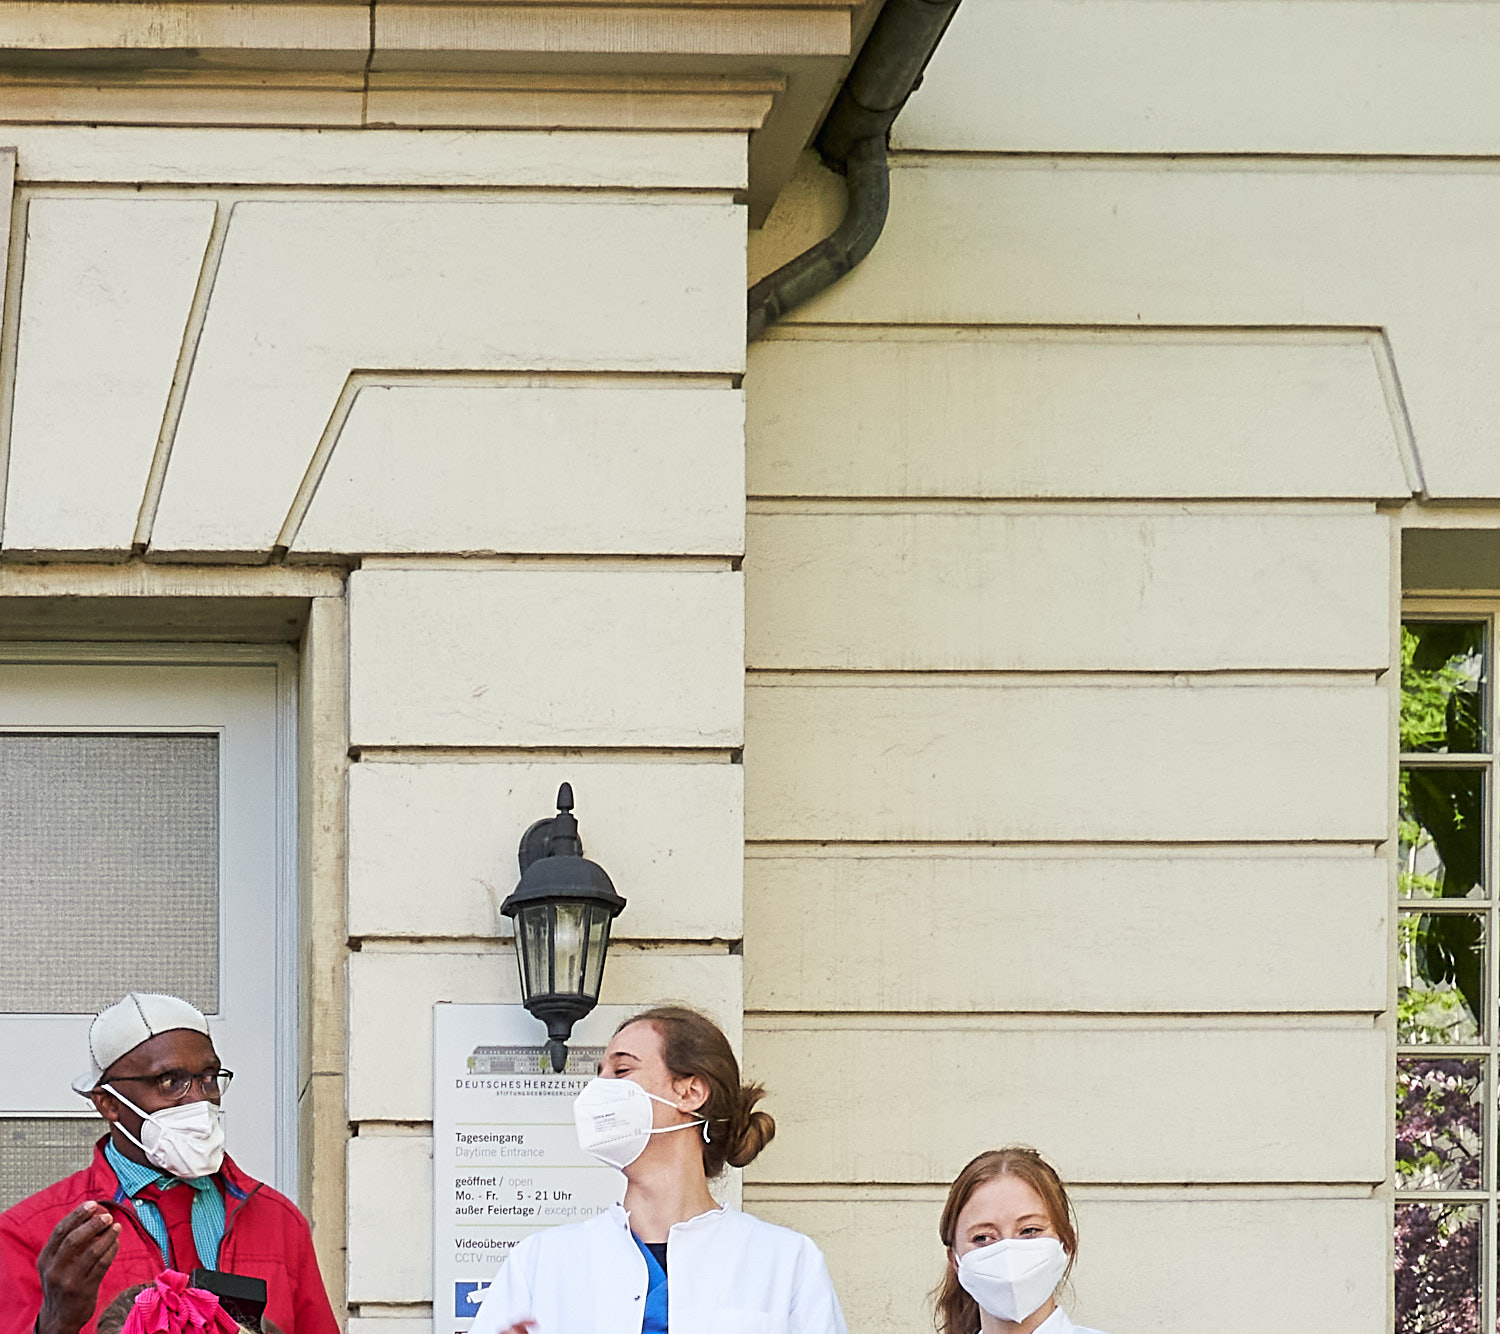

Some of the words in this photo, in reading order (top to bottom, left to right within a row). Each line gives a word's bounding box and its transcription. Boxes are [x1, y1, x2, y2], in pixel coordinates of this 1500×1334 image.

[455, 1079, 521, 1089] DEUTSCHES
[455, 1132, 524, 1145] Tageseingang
[455, 1146, 498, 1159] Daytime
[500, 1147, 545, 1157] Entrance
[455, 1176, 497, 1189] geöffnet
[508, 1178, 533, 1189] open
[455, 1190, 475, 1201] Mo.
[486, 1190, 498, 1201] Fr.
[516, 1190, 524, 1201] 5
[535, 1190, 548, 1201] 21
[553, 1190, 572, 1201] Uhr
[455, 1205, 484, 1215] außer
[487, 1204, 535, 1217] Feiertage
[542, 1205, 577, 1217] except
[455, 1239, 520, 1249] Videoüberw
[455, 1254, 483, 1264] CCTV
